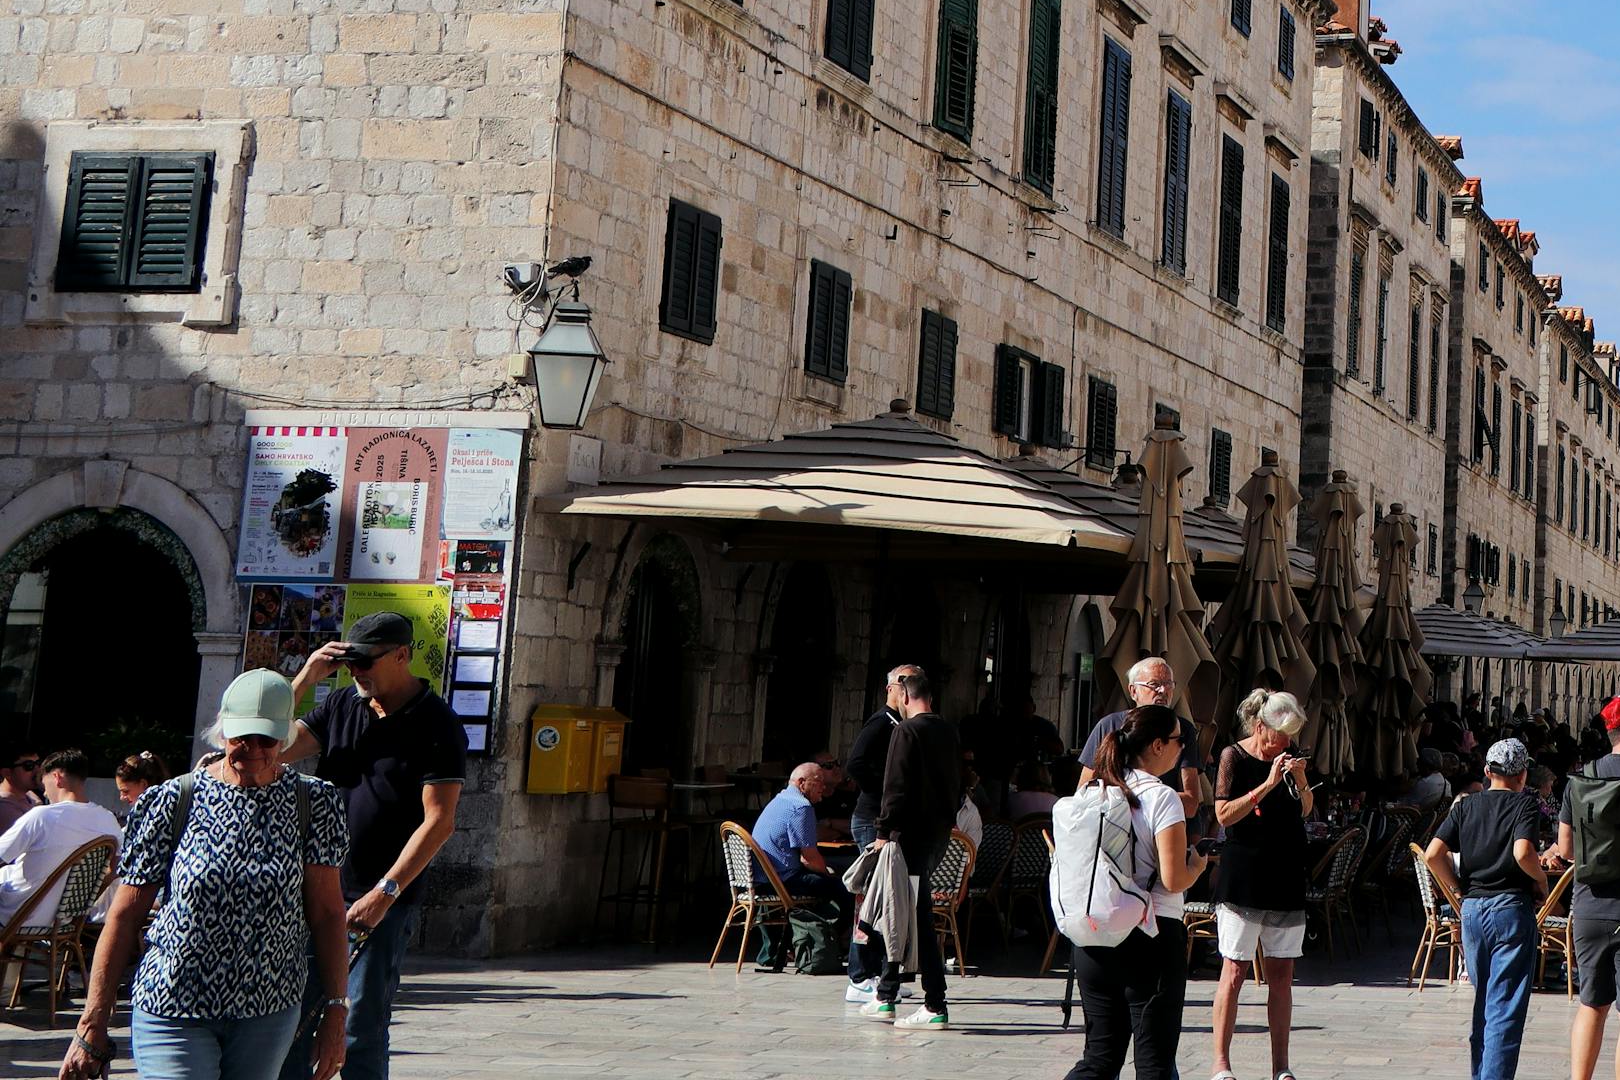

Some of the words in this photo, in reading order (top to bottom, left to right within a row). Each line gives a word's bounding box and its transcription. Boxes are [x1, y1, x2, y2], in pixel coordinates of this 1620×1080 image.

[320, 412, 453, 426] PUBLICITET
[353, 453, 365, 473] ART
[362, 430, 411, 453] RADIONICA
[411, 433, 438, 473] LAZARETI
[365, 482, 374, 508] OTOK
[412, 478, 421, 506] BORIS
